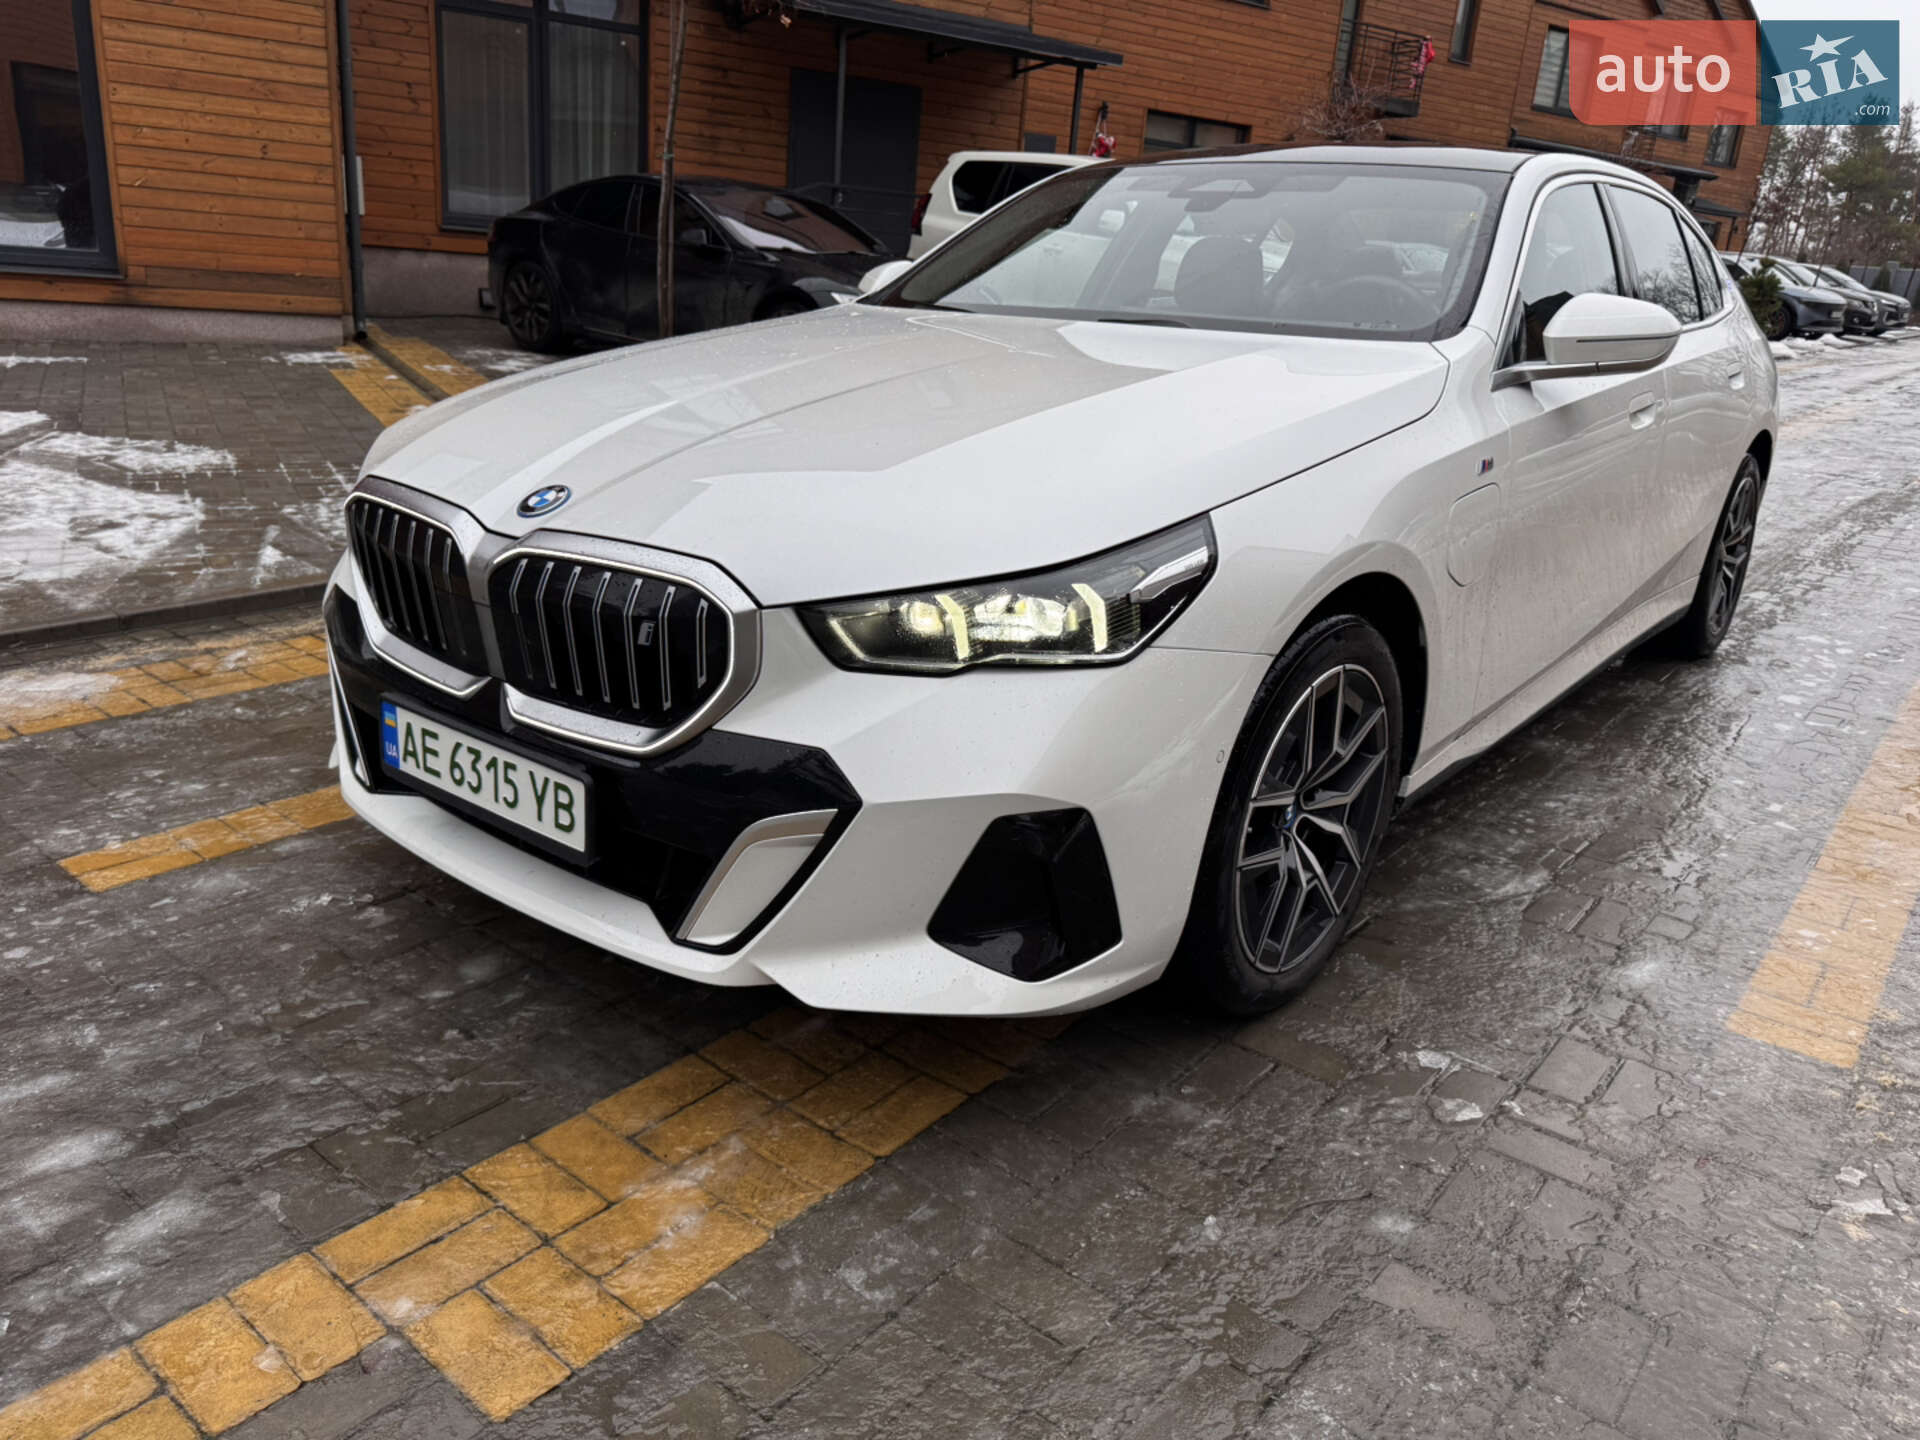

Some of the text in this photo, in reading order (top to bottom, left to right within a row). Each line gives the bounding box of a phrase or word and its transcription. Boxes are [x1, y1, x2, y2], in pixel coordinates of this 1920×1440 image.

[386, 742, 399, 759] UA
[402, 722, 575, 833] AE 6315 YB
